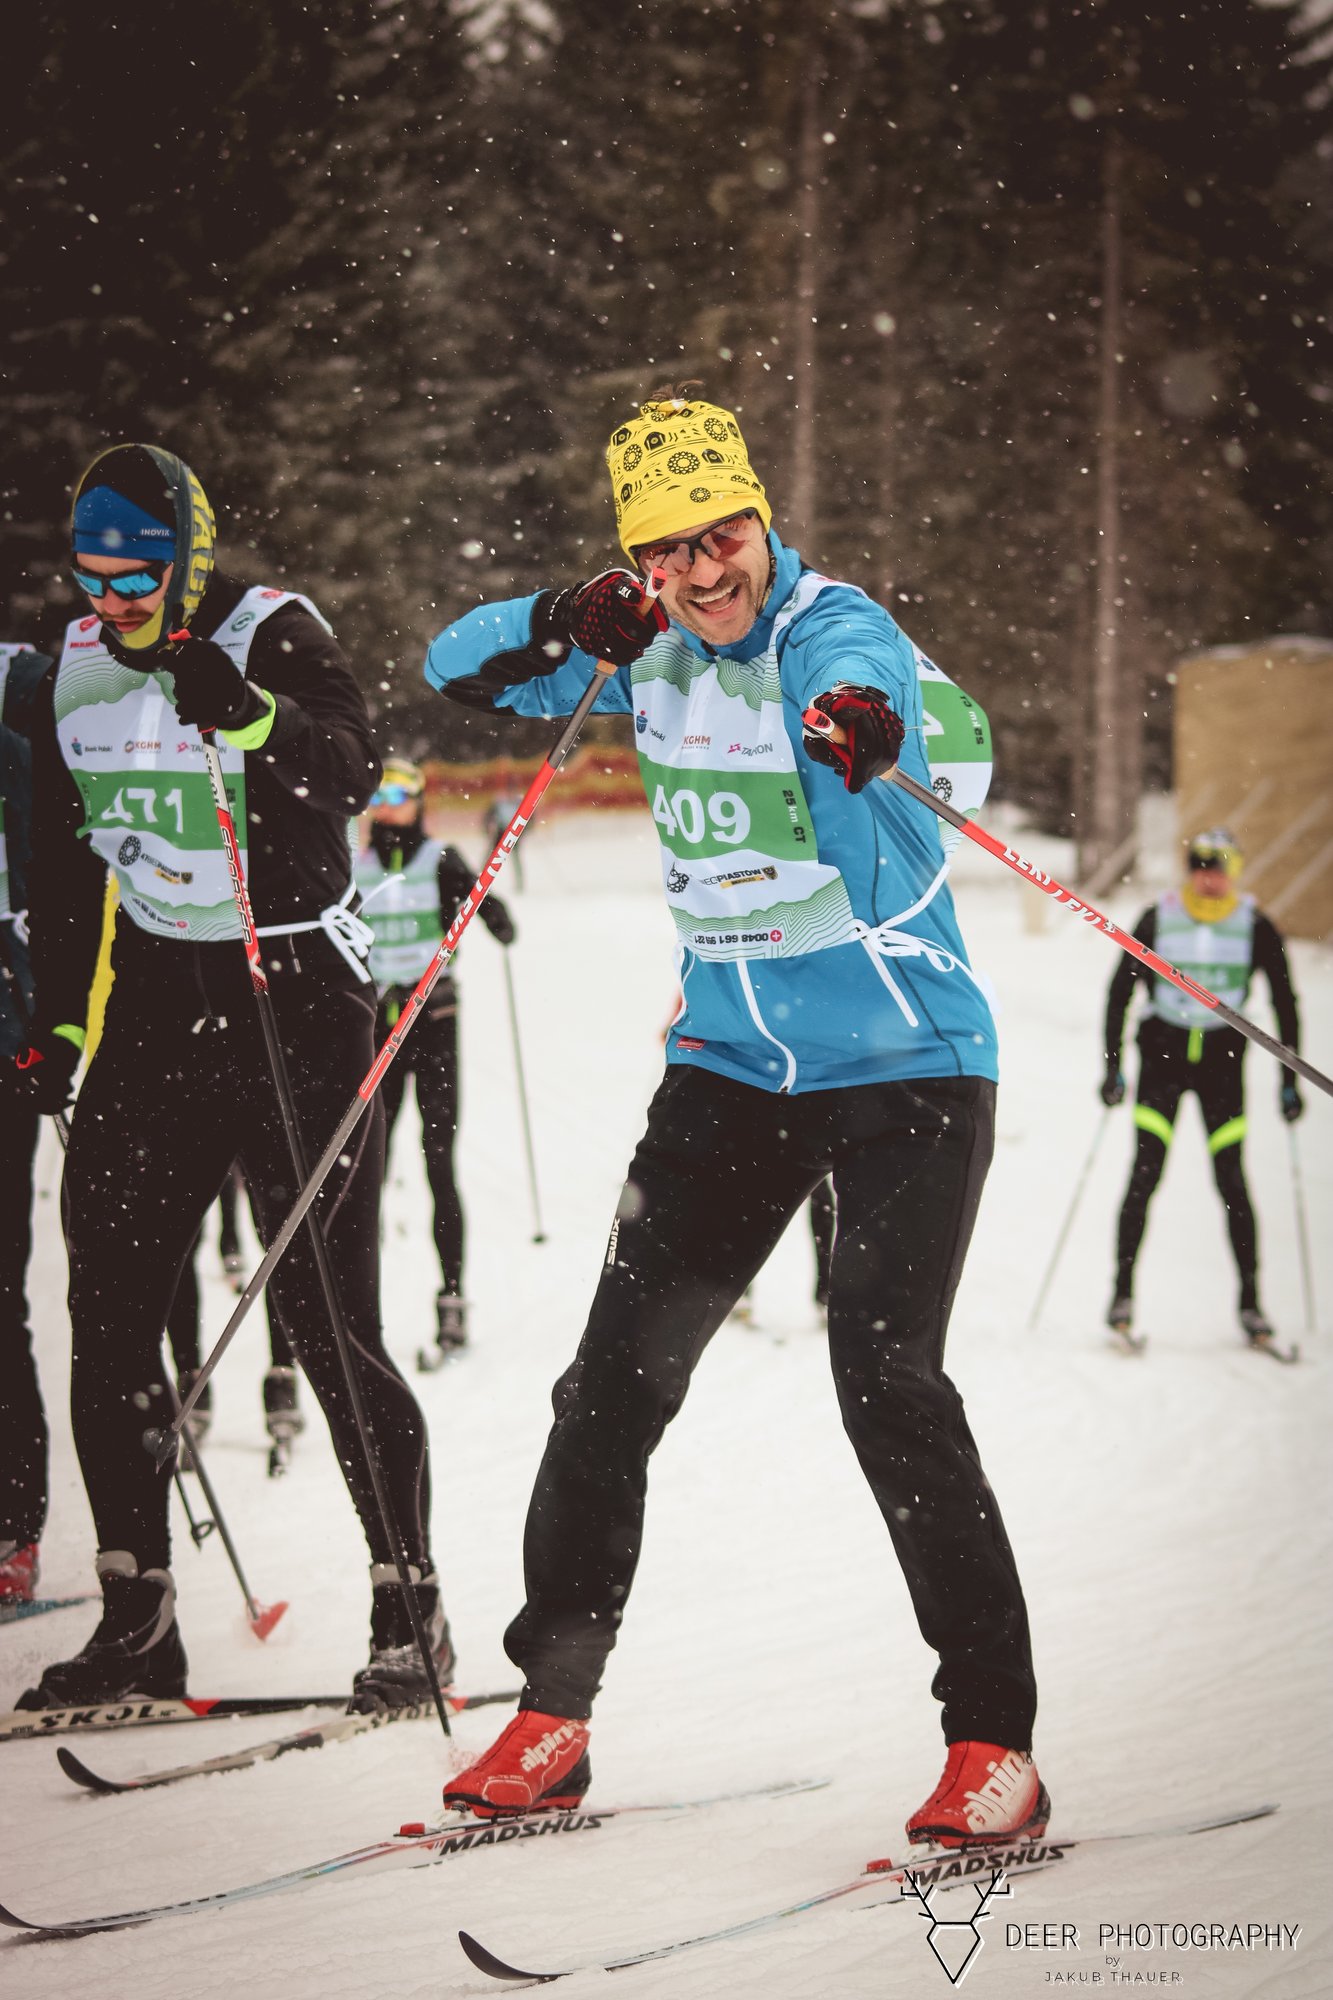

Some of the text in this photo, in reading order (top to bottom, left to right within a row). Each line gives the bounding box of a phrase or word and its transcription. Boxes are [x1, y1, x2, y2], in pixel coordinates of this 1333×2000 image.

[135, 741, 162, 750] KGHM
[683, 735, 712, 746] KGHM
[101, 787, 184, 834] 471
[652, 784, 751, 844] 409
[487, 814, 528, 879] LEKI
[1003, 847, 1051, 886] LEKI
[718, 934, 739, 945] 661
[741, 932, 770, 944] 0048
[438, 1813, 614, 1857] MADSHUS
[909, 1842, 1075, 1890] MADSHUS
